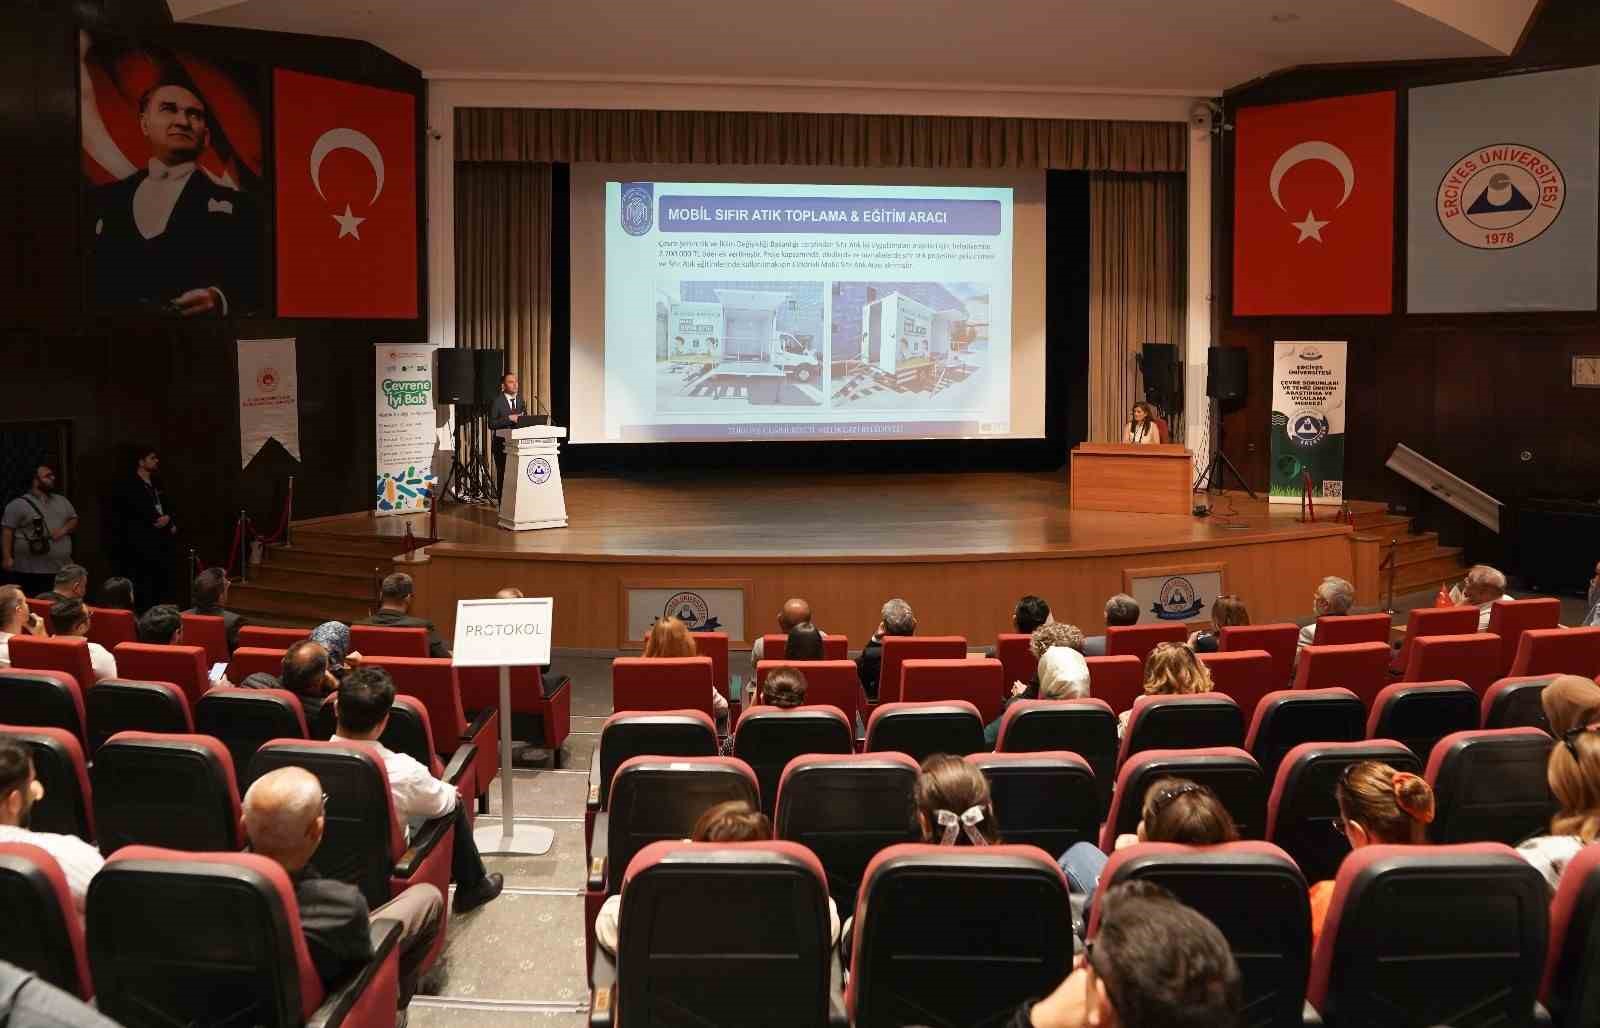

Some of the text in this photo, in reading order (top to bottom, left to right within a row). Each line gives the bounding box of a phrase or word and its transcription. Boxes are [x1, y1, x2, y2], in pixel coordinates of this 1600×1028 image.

[668, 205, 947, 224] MOBİL SIFIR ATIK TOPLAMA & EĞİTİM ARACI
[1485, 232, 1514, 244] 1978
[383, 381, 430, 394] Çevrene
[404, 393, 425, 404] Bak
[465, 623, 545, 637] PROTOKOL
